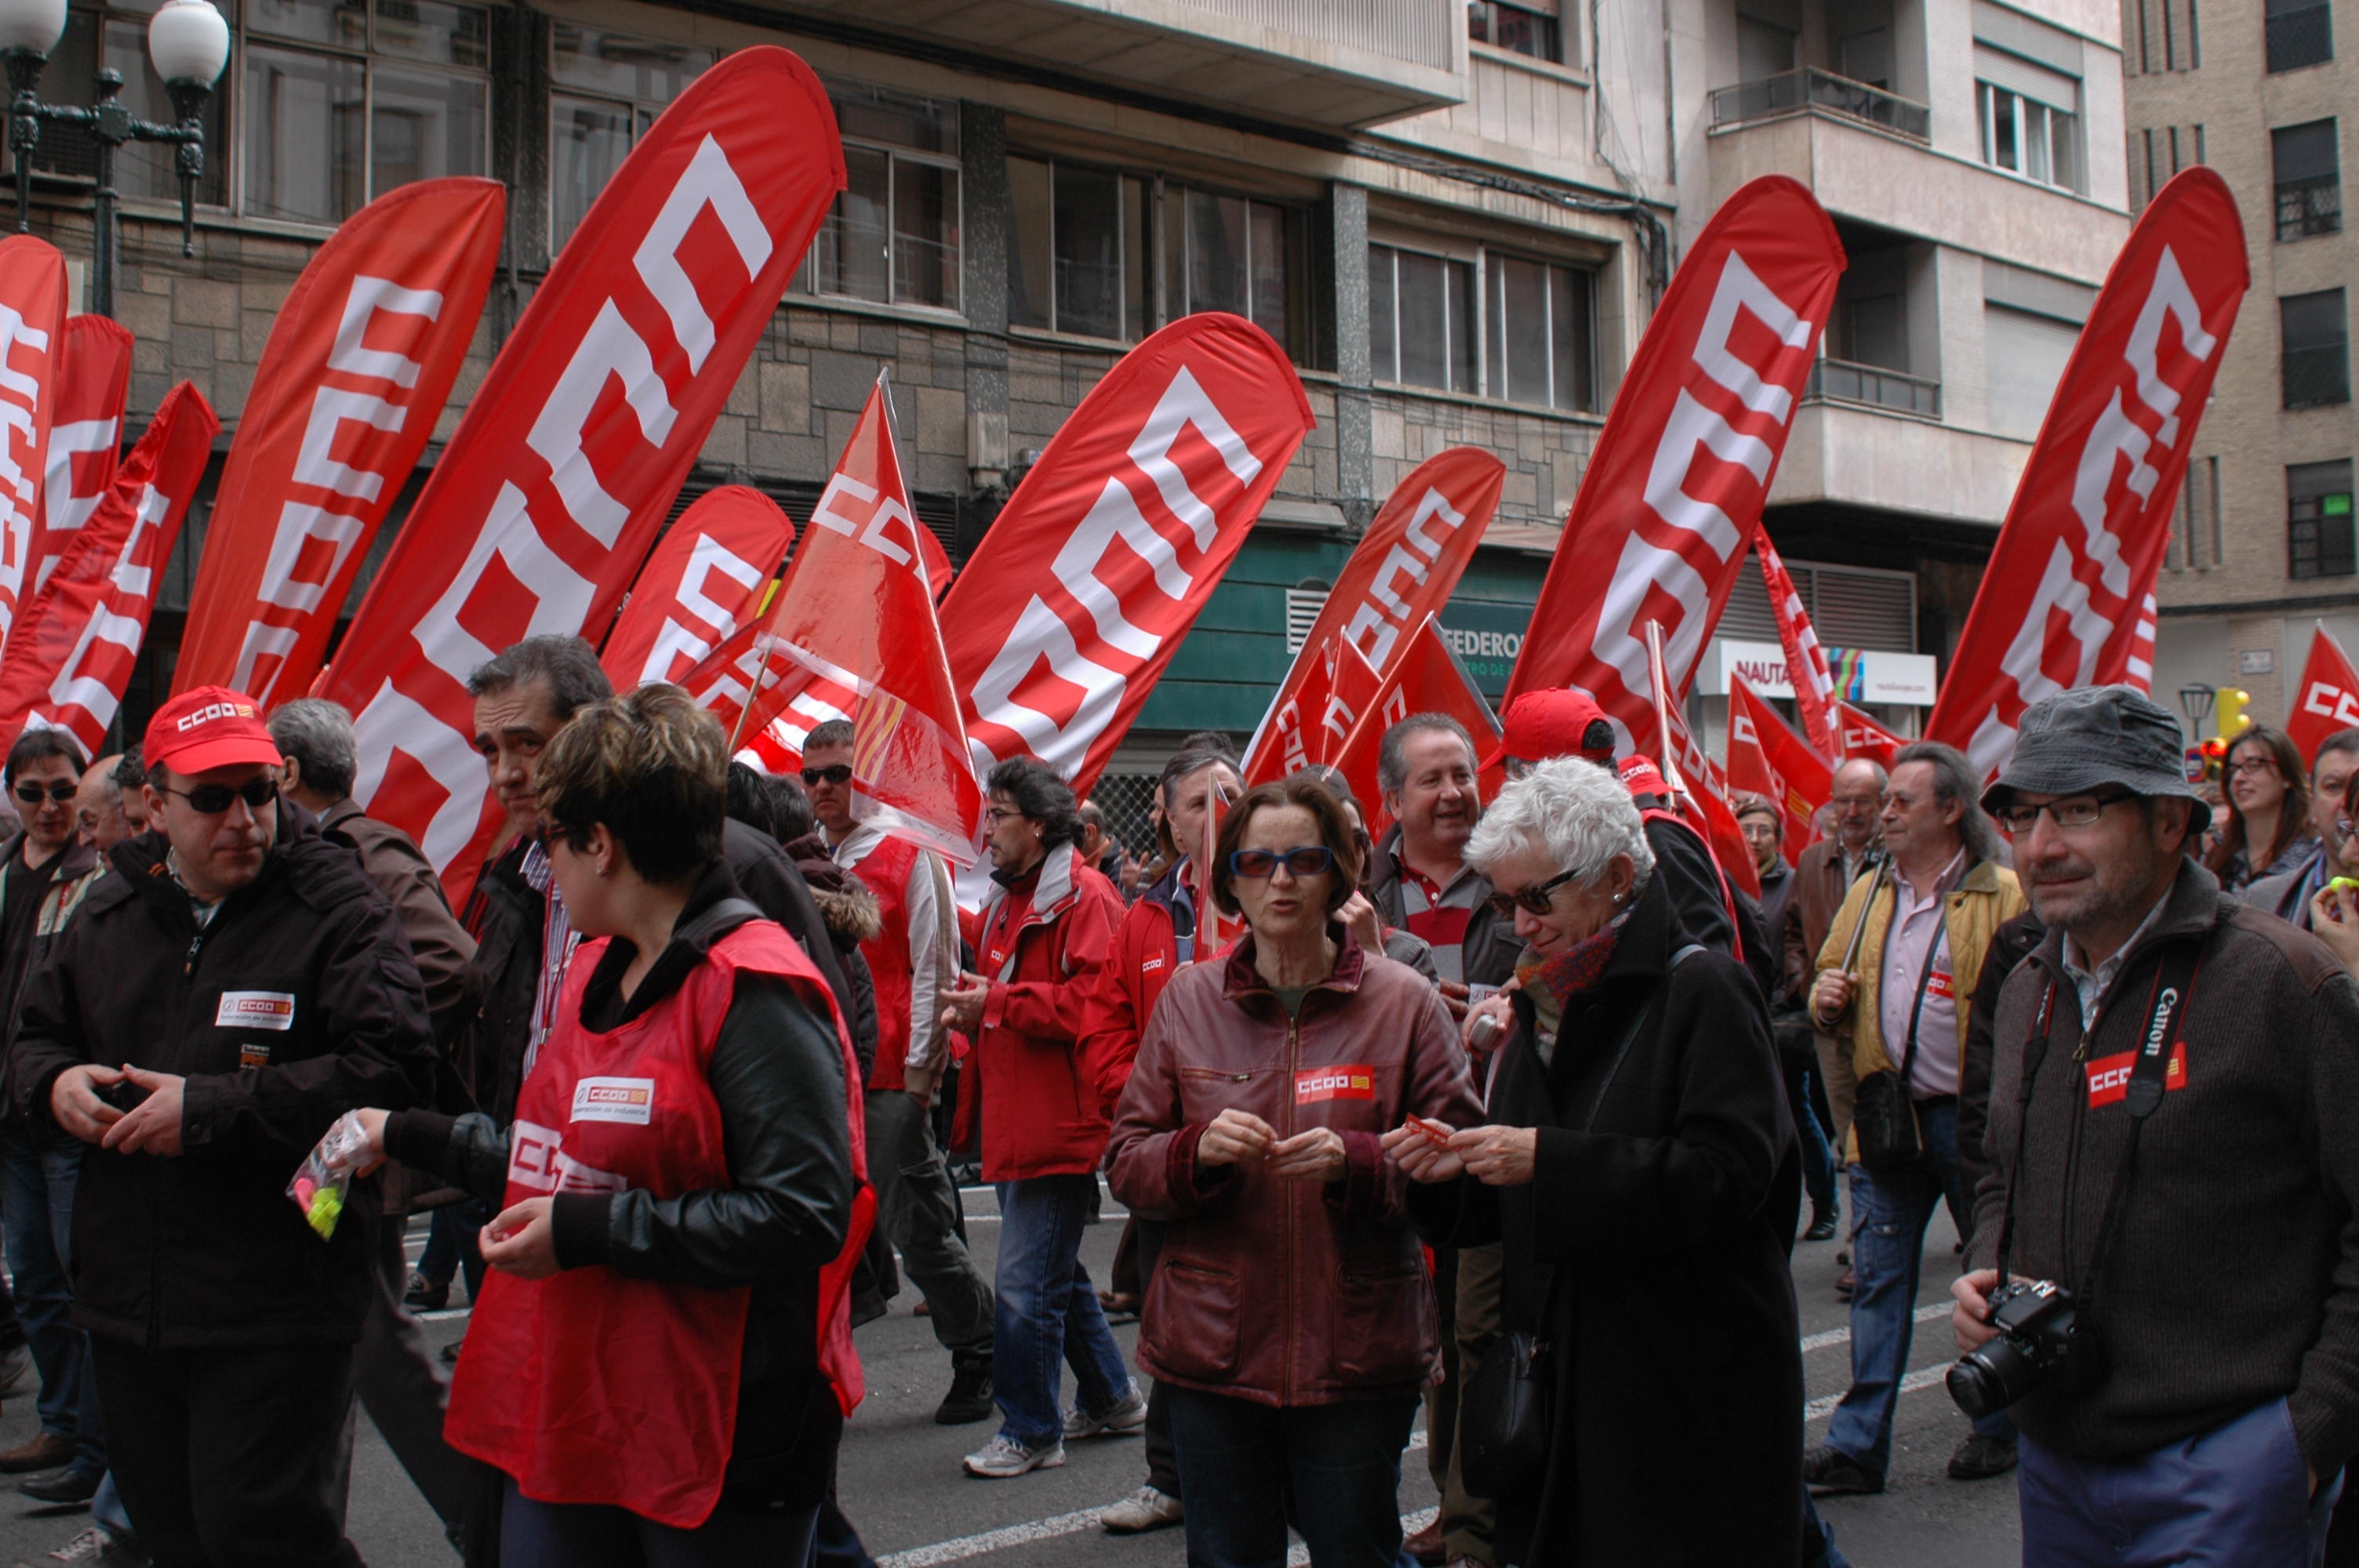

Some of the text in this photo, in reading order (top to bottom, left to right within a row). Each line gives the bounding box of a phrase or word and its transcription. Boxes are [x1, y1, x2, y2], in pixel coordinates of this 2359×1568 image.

[177, 702, 236, 731] CCOO
[1620, 763, 1651, 783] CCOO
[239, 1000, 274, 1013] CCOO
[2146, 988, 2178, 1056] Canon
[1298, 1075, 1348, 1094] CCOO
[590, 1090, 629, 1101] CCOO
